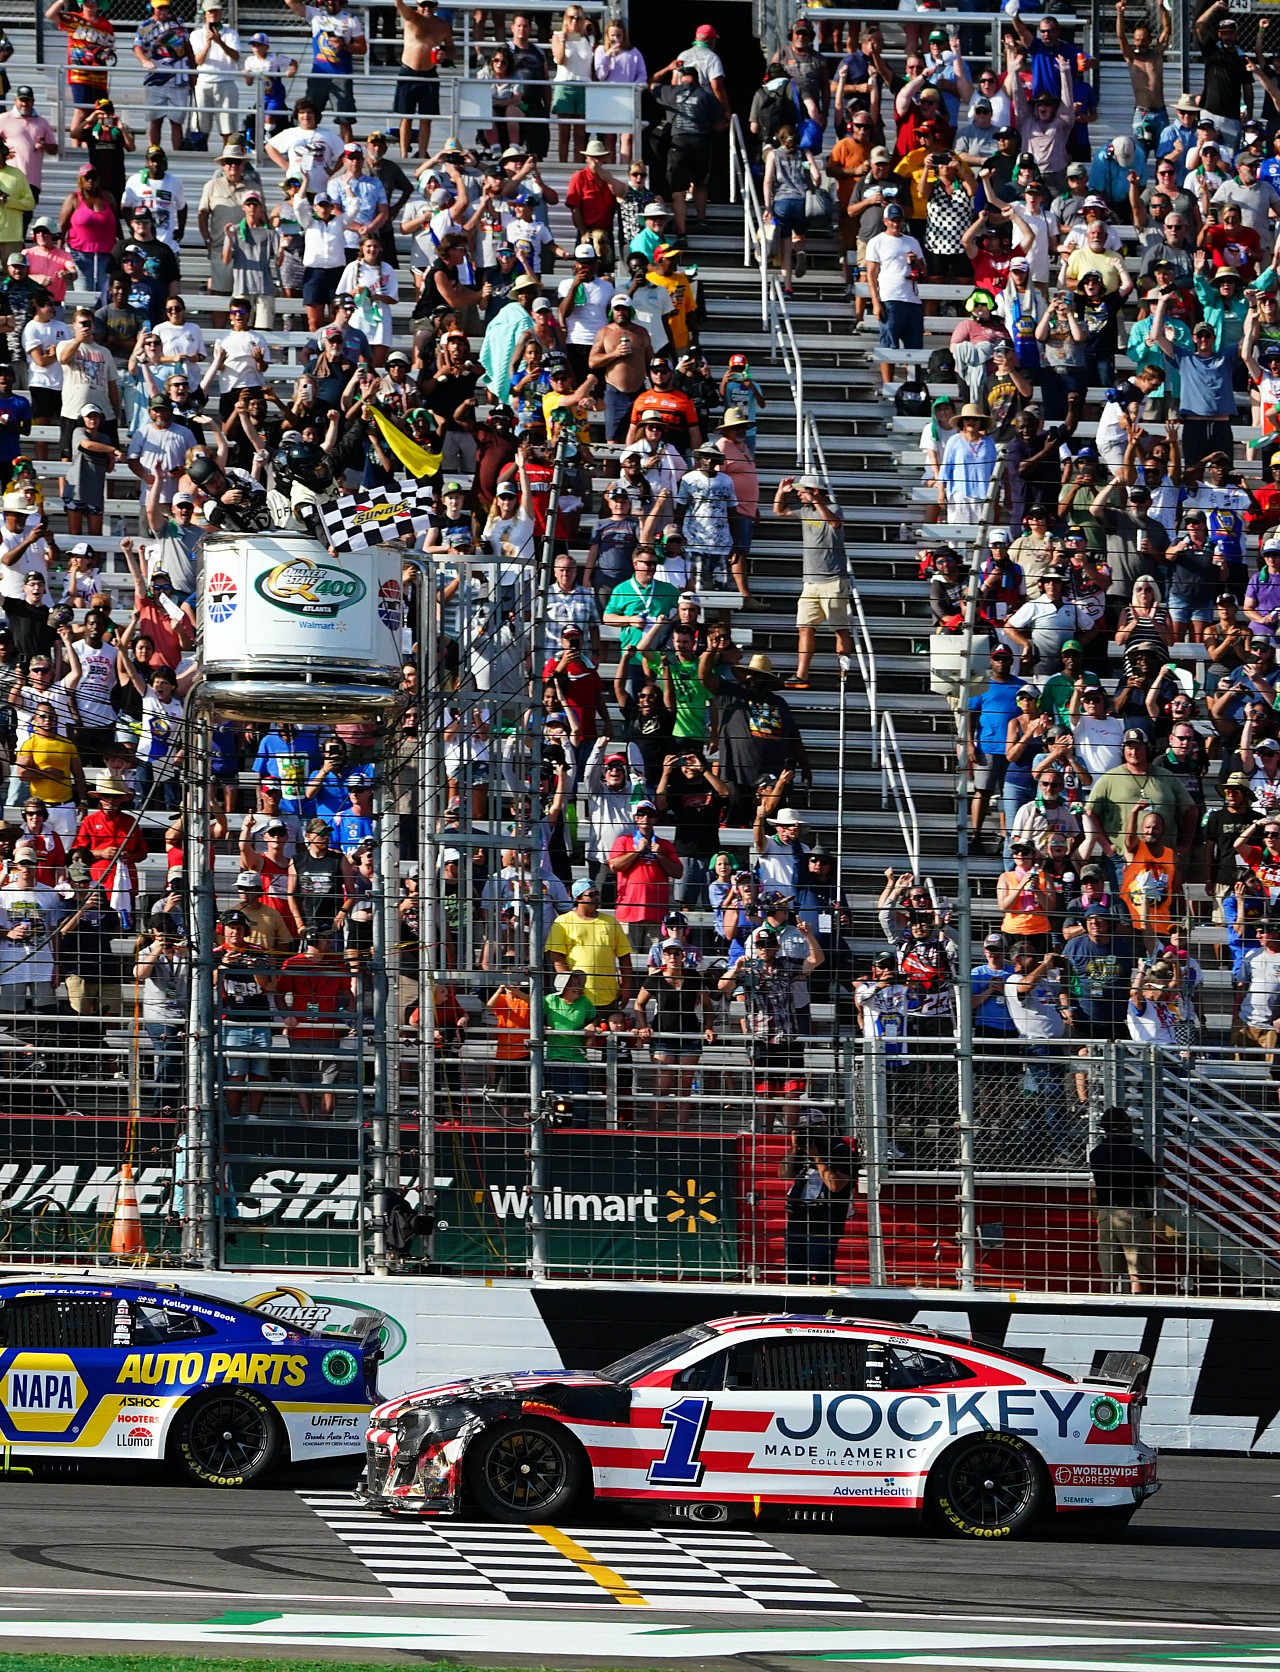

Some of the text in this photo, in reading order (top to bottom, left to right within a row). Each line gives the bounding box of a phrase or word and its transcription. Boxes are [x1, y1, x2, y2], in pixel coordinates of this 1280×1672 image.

[356, 500, 411, 525] SUNOCO
[282, 568, 326, 578] QUAKER
[286, 577, 358, 597] STATE 400
[298, 620, 335, 630] Walmart
[163, 1298, 237, 1323] Kelley Blue Book
[116, 1352, 204, 1385] AUTO
[205, 1352, 309, 1387] PARTS
[12, 1373, 74, 1409] NAPA
[234, 1388, 268, 1413] EAGLE
[117, 1414, 160, 1424] HOOTERS
[310, 1414, 359, 1427] UniFirst
[775, 1390, 1086, 1442] JOCKEY
[116, 1434, 155, 1447] LLumar
[326, 1431, 343, 1440] Auto
[343, 1431, 360, 1440] Parts
[647, 1396, 711, 1485] 1
[984, 1432, 1025, 1450] EAGLE
[764, 1444, 818, 1457] MADE
[826, 1448, 837, 1457] in
[810, 1458, 883, 1467] COLLECTION
[1072, 1466, 1139, 1477] WORLDWIDE
[1073, 1476, 1115, 1485] EXPRESS
[1063, 1496, 1095, 1504] SIEMENS
[938, 1497, 1011, 1538] GOODYEAR
